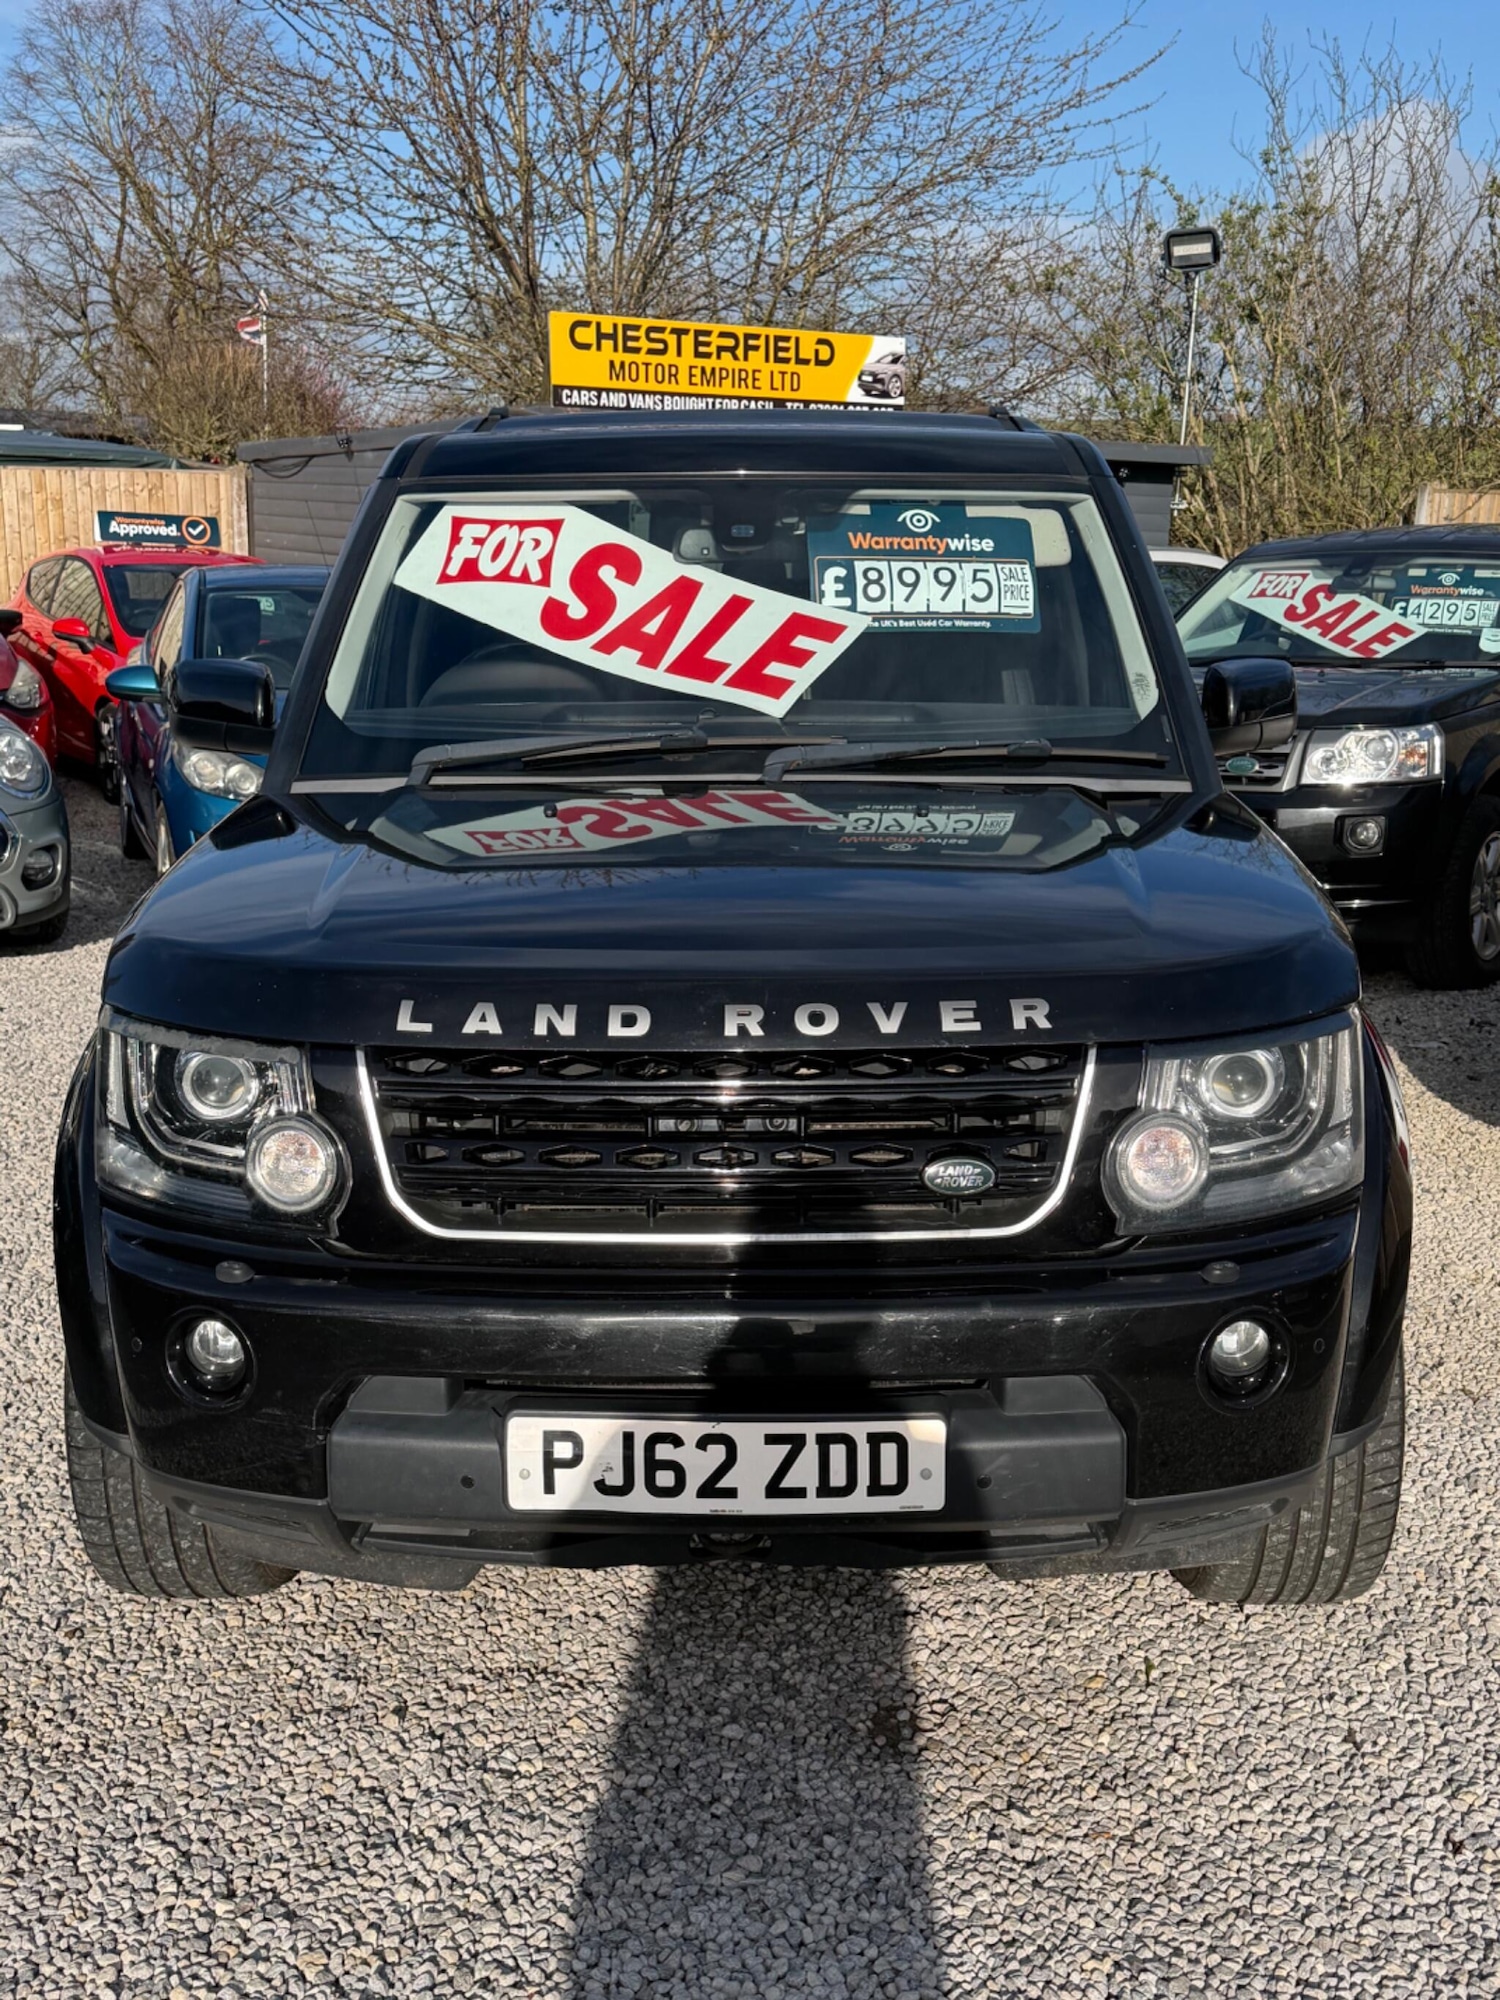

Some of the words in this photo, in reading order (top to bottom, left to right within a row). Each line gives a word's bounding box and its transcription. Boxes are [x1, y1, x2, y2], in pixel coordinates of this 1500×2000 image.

[568, 319, 836, 367] CHESTERFIELD
[608, 360, 679, 386] MOTOR
[688, 365, 763, 391] EMPIRE
[769, 370, 801, 392] LTD
[562, 388, 598, 406] CARS
[600, 391, 627, 408] AND
[628, 393, 662, 410] VANS
[664, 395, 714, 411] BOUGHT
[445, 523, 555, 583] FOR
[848, 532, 995, 554] Warrantywise
[821, 565, 994, 607] £8995
[1000, 566, 1029, 583] SALE
[1252, 573, 1304, 598] FOR
[1003, 584, 1030, 602] PRICE
[1410, 585, 1485, 598] Warrantywise
[540, 542, 849, 700] SALE
[938, 620, 953, 628] Car
[1283, 583, 1417, 659] SALE
[396, 1000, 652, 1038] LAND
[723, 998, 1054, 1037] ROVER
[938, 1165, 974, 1177] LAND
[940, 1175, 985, 1188] ROVER
[542, 1430, 739, 1500] PJ62
[763, 1430, 910, 1500] ZDD
